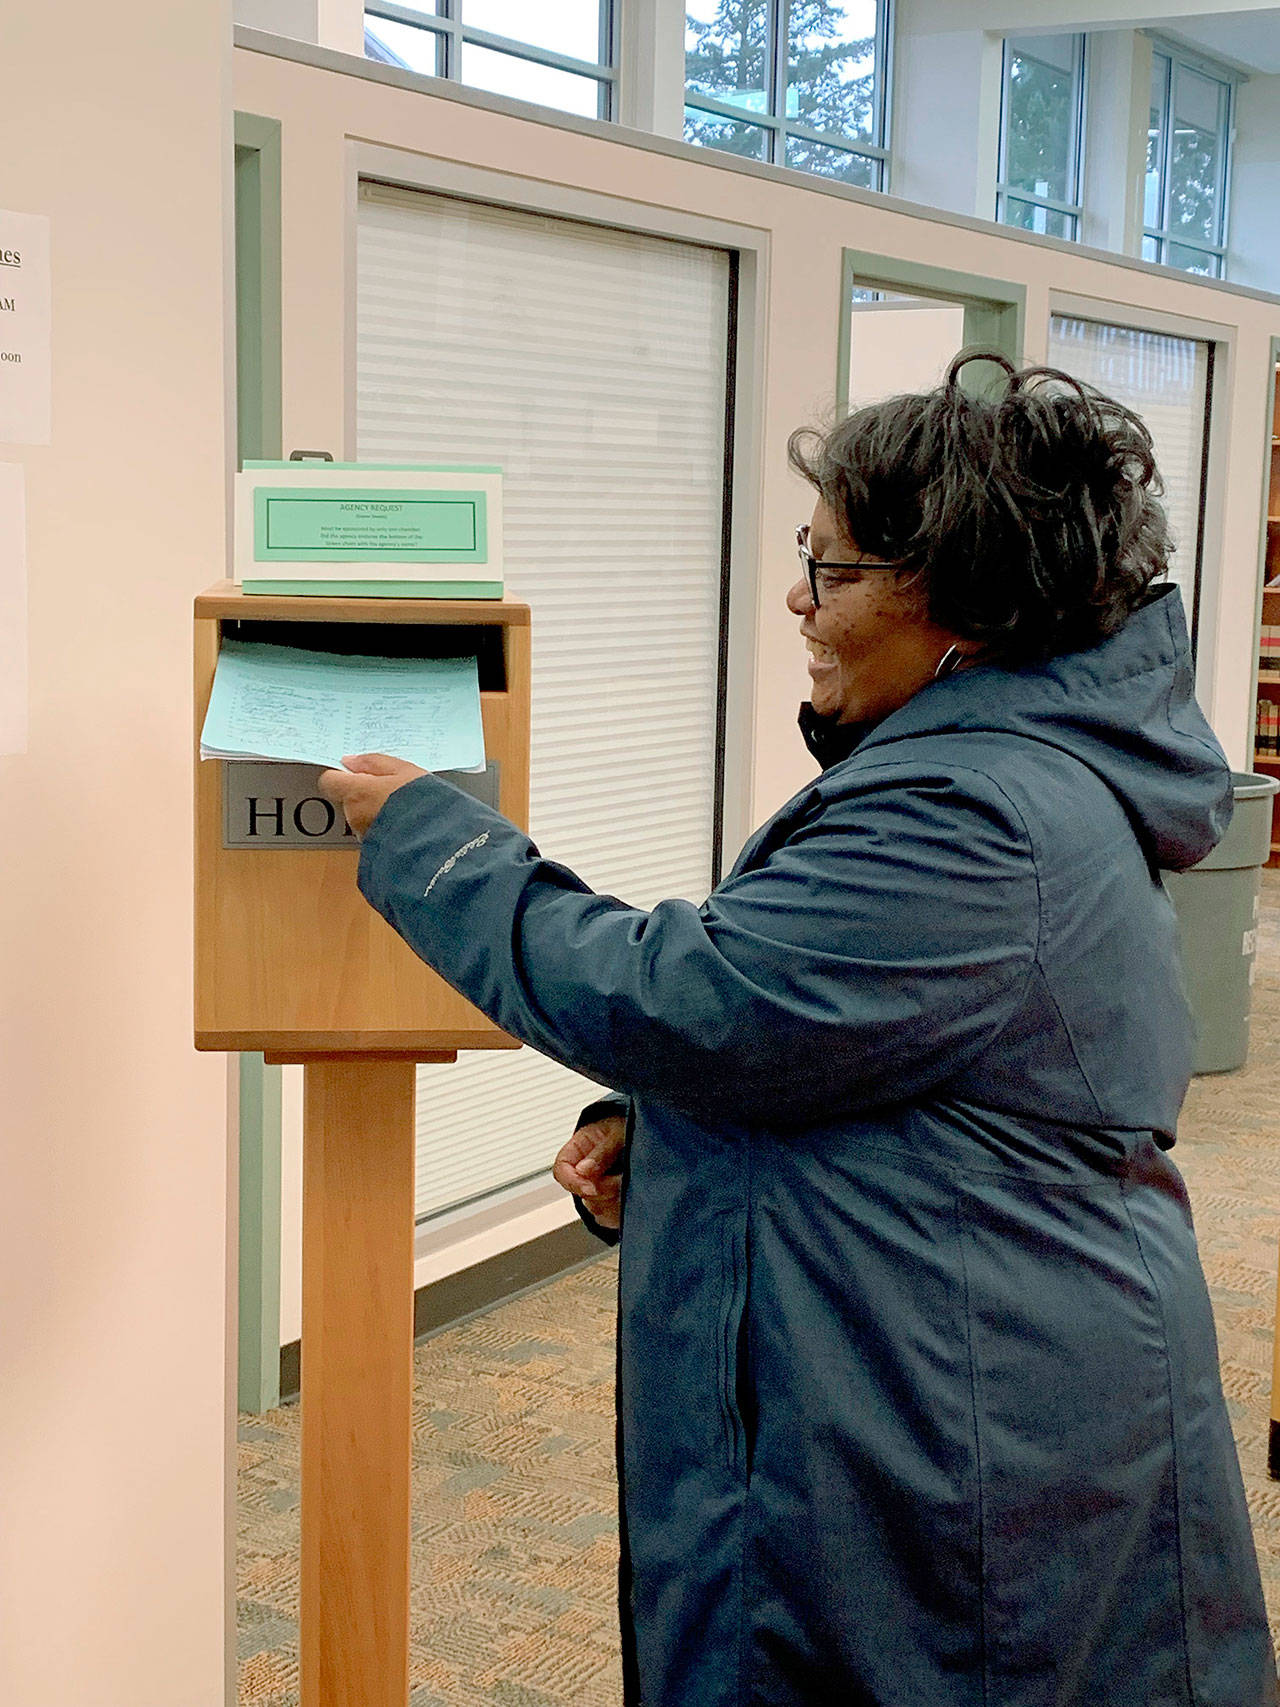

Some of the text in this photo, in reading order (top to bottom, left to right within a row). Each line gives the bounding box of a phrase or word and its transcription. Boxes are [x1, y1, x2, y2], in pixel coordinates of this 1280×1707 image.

[340, 503, 403, 513] AGENCY REQUEST
[246, 796, 356, 837] HO
